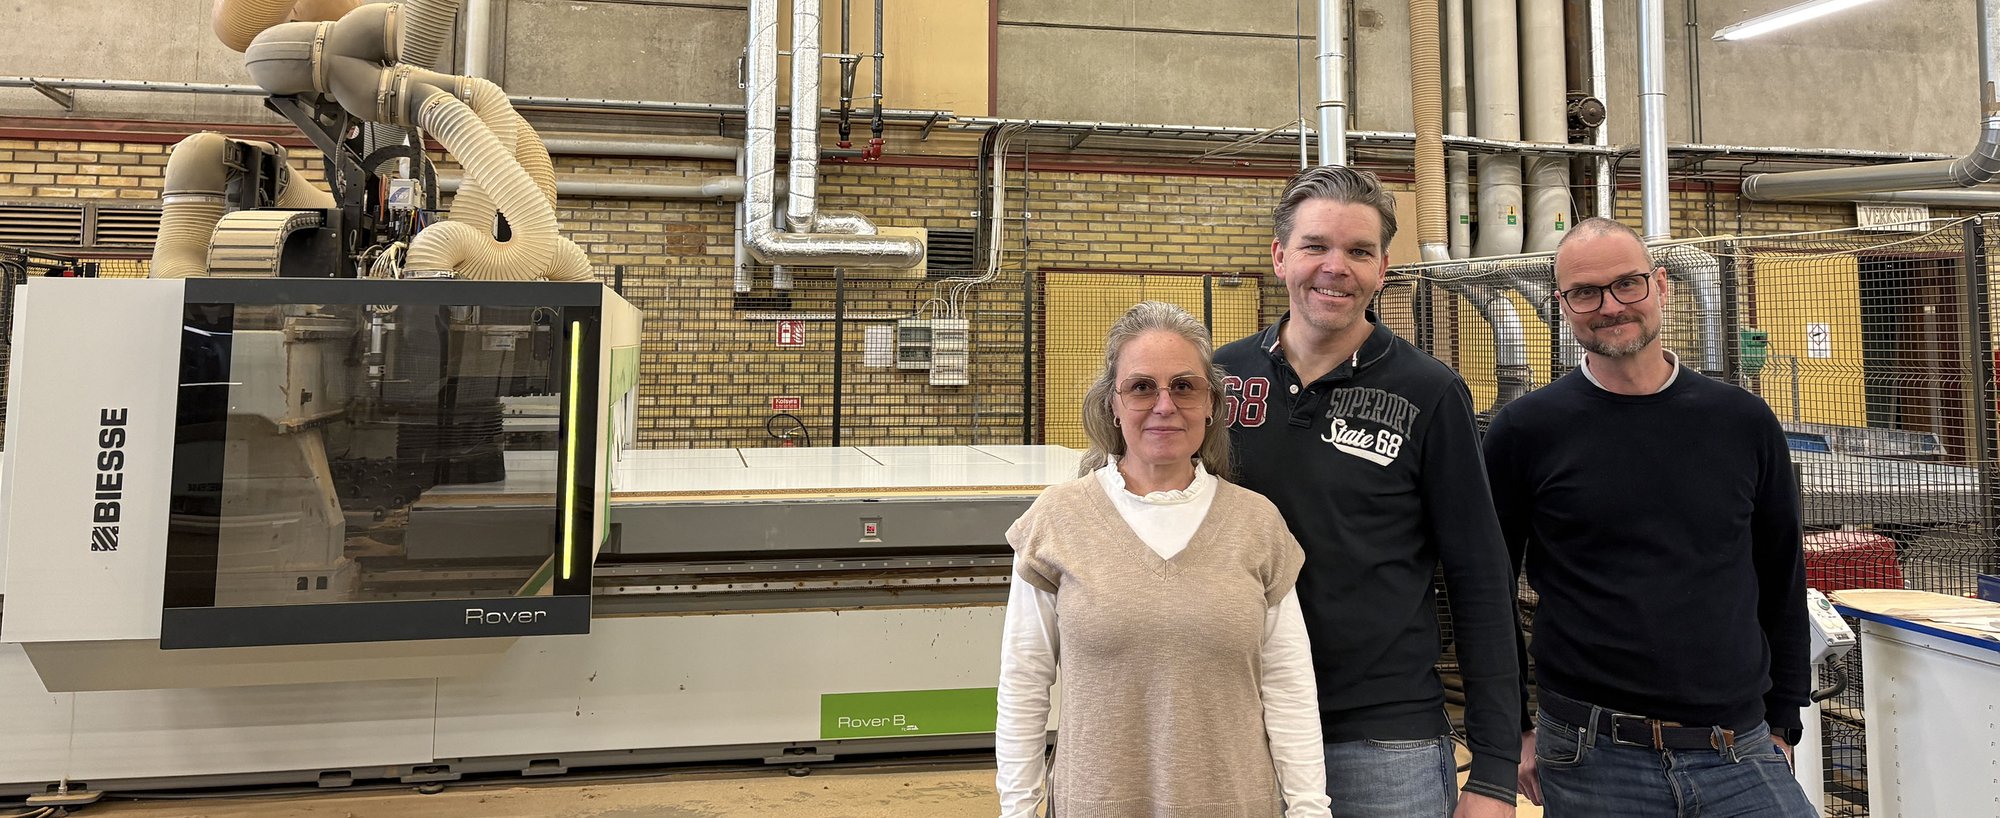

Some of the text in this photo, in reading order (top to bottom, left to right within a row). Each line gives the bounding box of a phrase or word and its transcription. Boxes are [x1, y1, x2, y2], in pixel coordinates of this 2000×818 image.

[1221, 376, 1271, 428] 68
[1325, 386, 1422, 442] SUPERDRY
[1320, 417, 1403, 459] State 68
[93, 408, 128, 523] BIESSE
[465, 608, 547, 625] Rover
[838, 715, 891, 729] Rover
[893, 714, 906, 726] B
